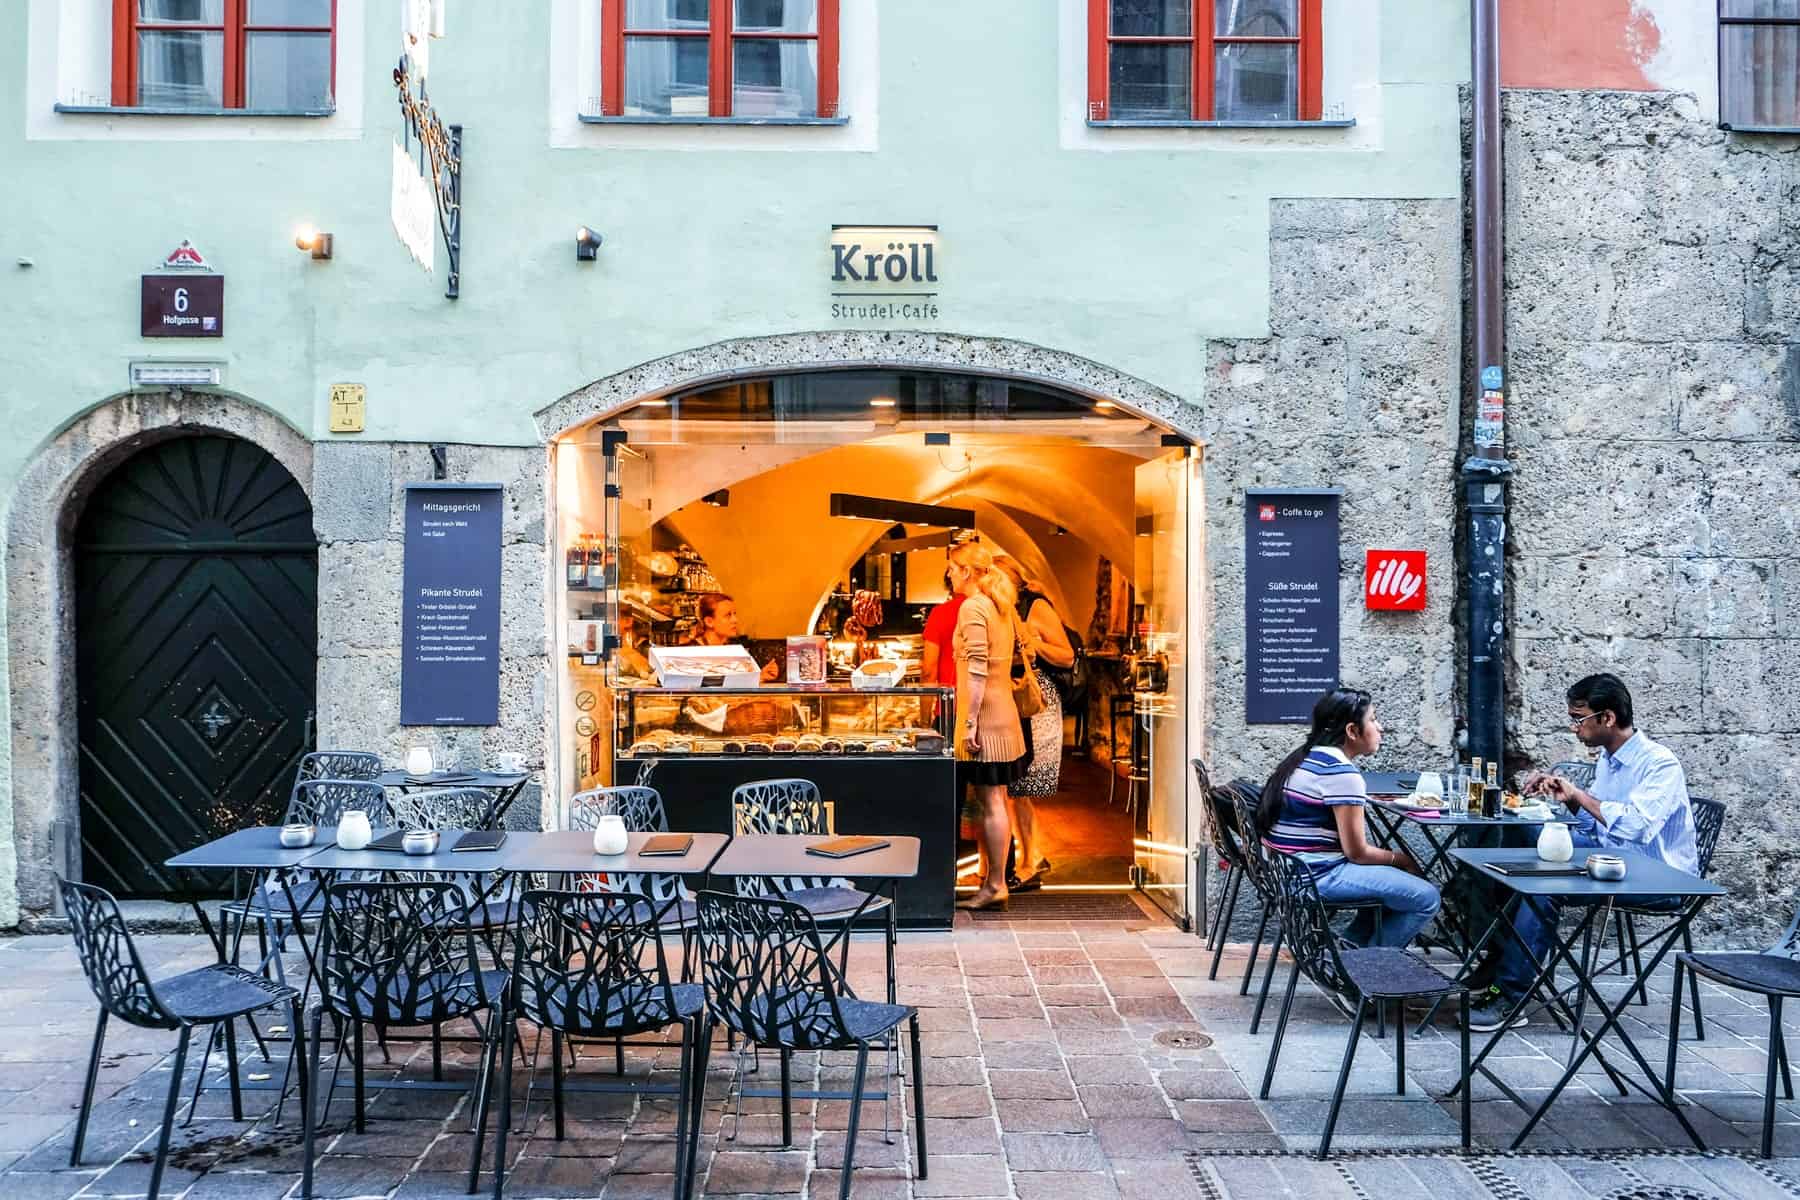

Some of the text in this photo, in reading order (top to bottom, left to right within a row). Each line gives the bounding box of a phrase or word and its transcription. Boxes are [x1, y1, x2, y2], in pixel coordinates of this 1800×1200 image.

[832, 242, 938, 282] Kröll
[174, 288, 189, 312] 6
[163, 314, 199, 326] Hofgasse
[423, 503, 481, 513] Mittagsgericht
[1304, 508, 1312, 516] to
[1313, 510, 1324, 518] go
[1268, 582, 1318, 591] Süße Strudel
[1369, 559, 1422, 605] illy
[421, 588, 483, 598] Pikante Strudel
